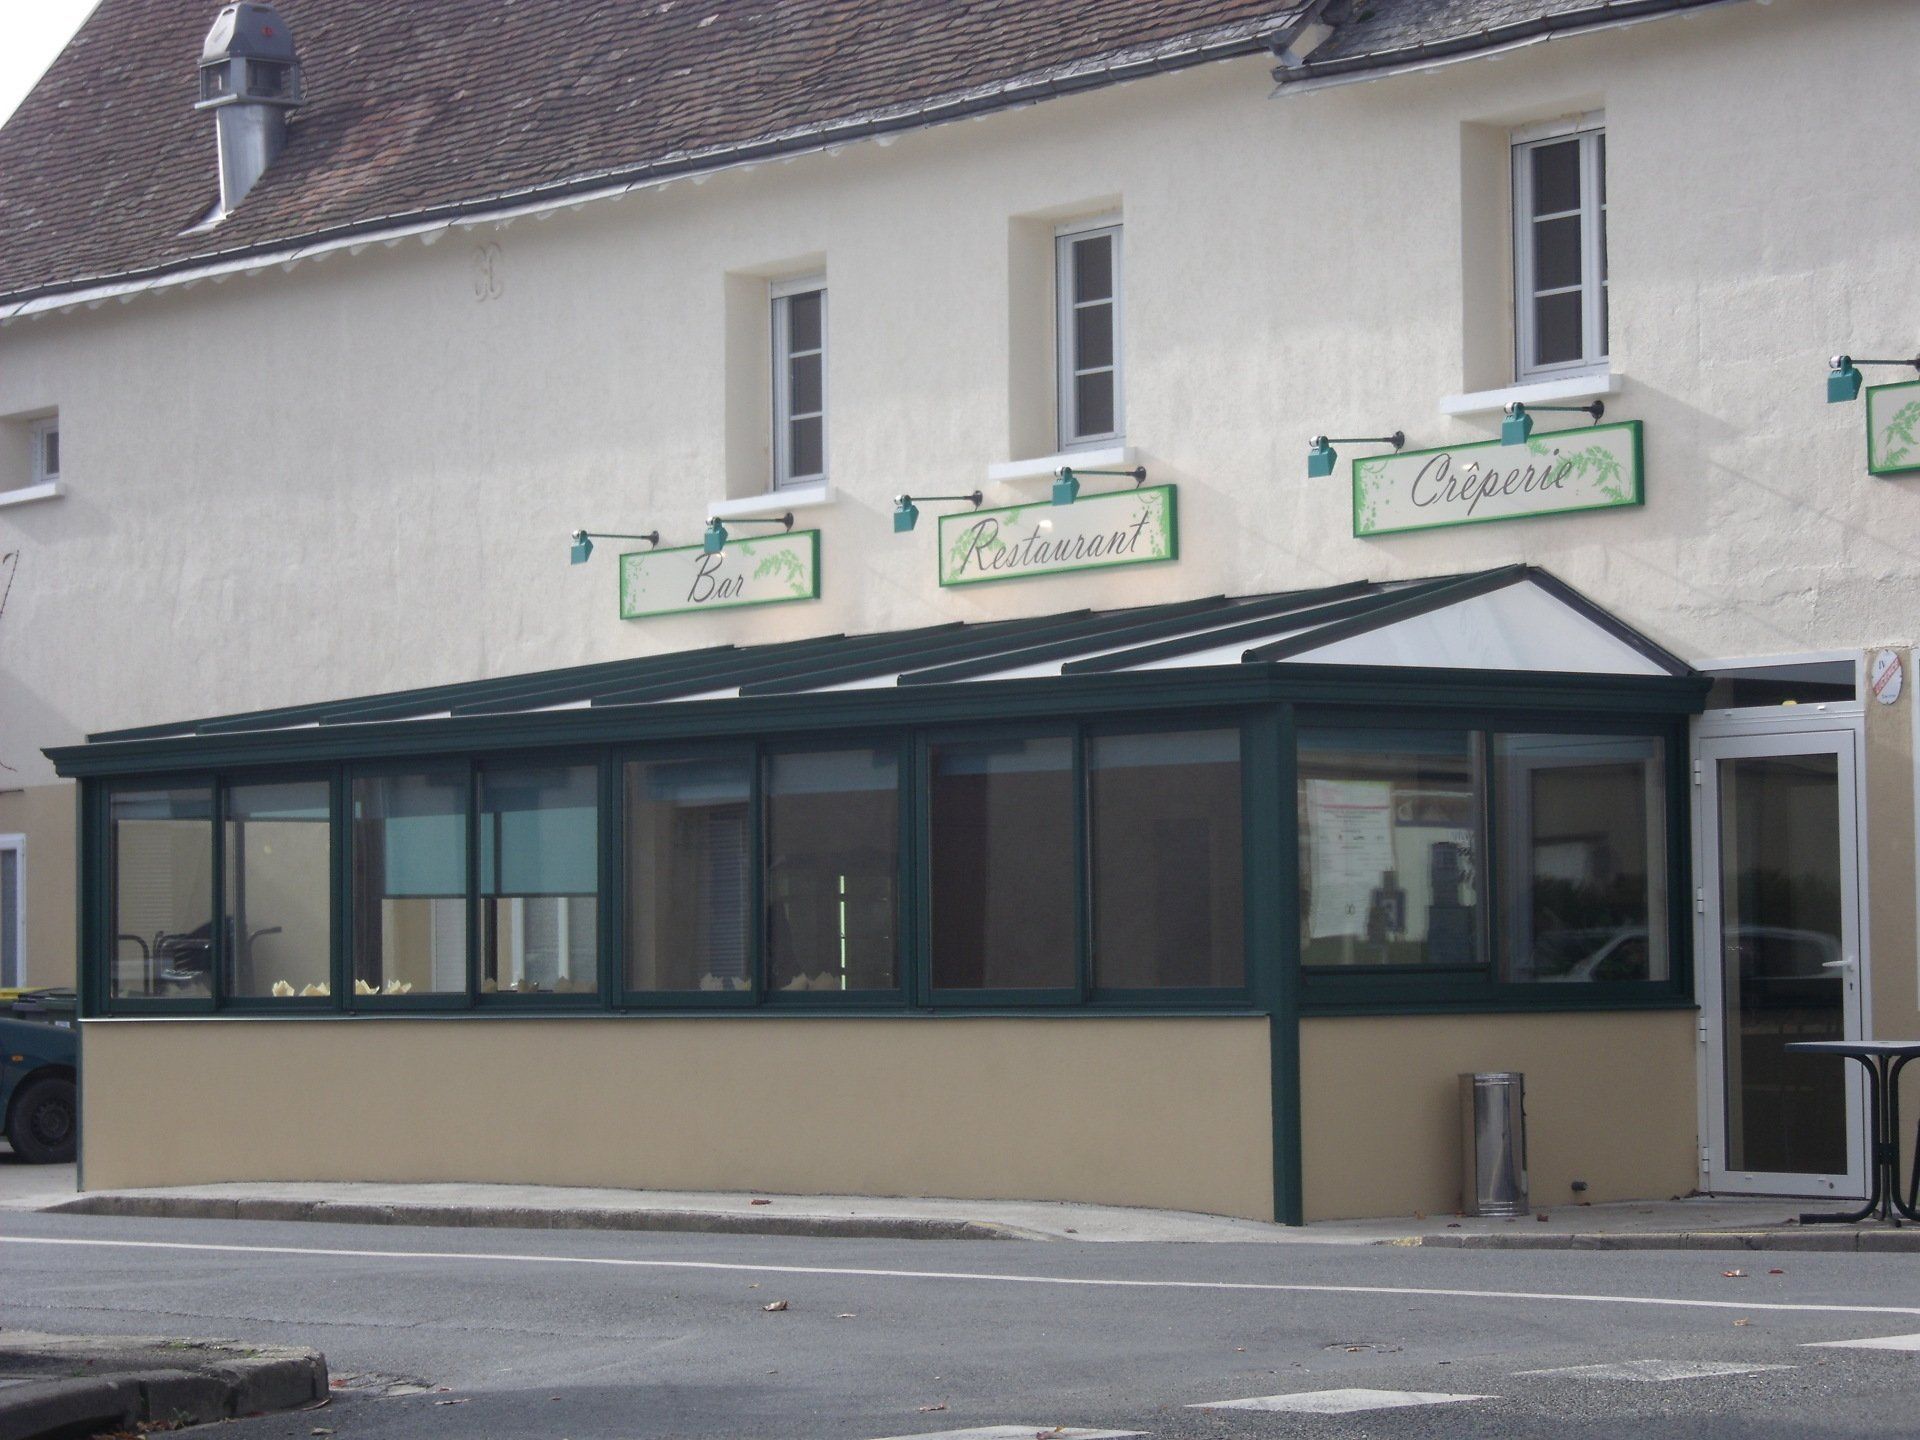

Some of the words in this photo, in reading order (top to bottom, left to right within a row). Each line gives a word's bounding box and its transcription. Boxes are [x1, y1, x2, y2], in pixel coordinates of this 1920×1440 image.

[1411, 448, 1573, 517] Crêperie
[959, 510, 1150, 575] Restaurant
[688, 552, 744, 602] Bar
